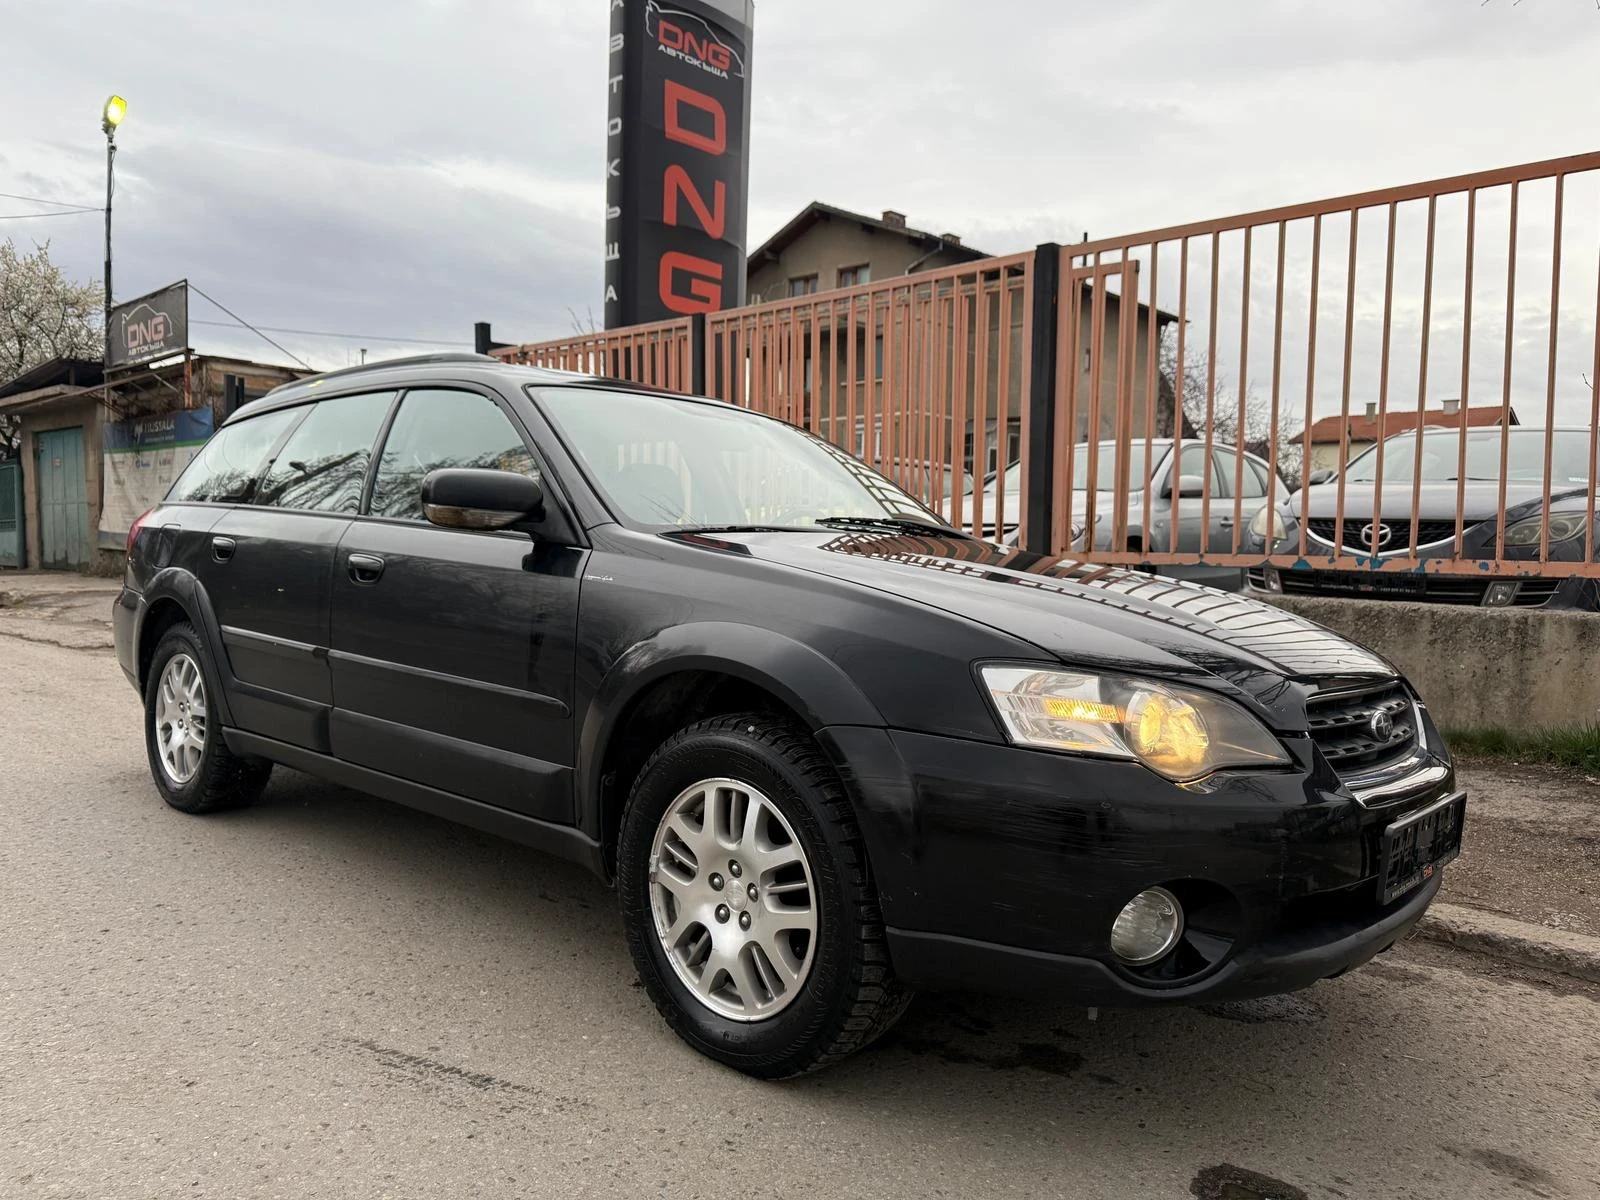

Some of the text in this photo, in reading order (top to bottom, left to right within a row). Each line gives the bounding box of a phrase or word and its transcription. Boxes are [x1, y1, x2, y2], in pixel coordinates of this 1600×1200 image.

[659, 20, 731, 70] DNG
[659, 79, 727, 315] DNG
[128, 316, 164, 349] DNG
